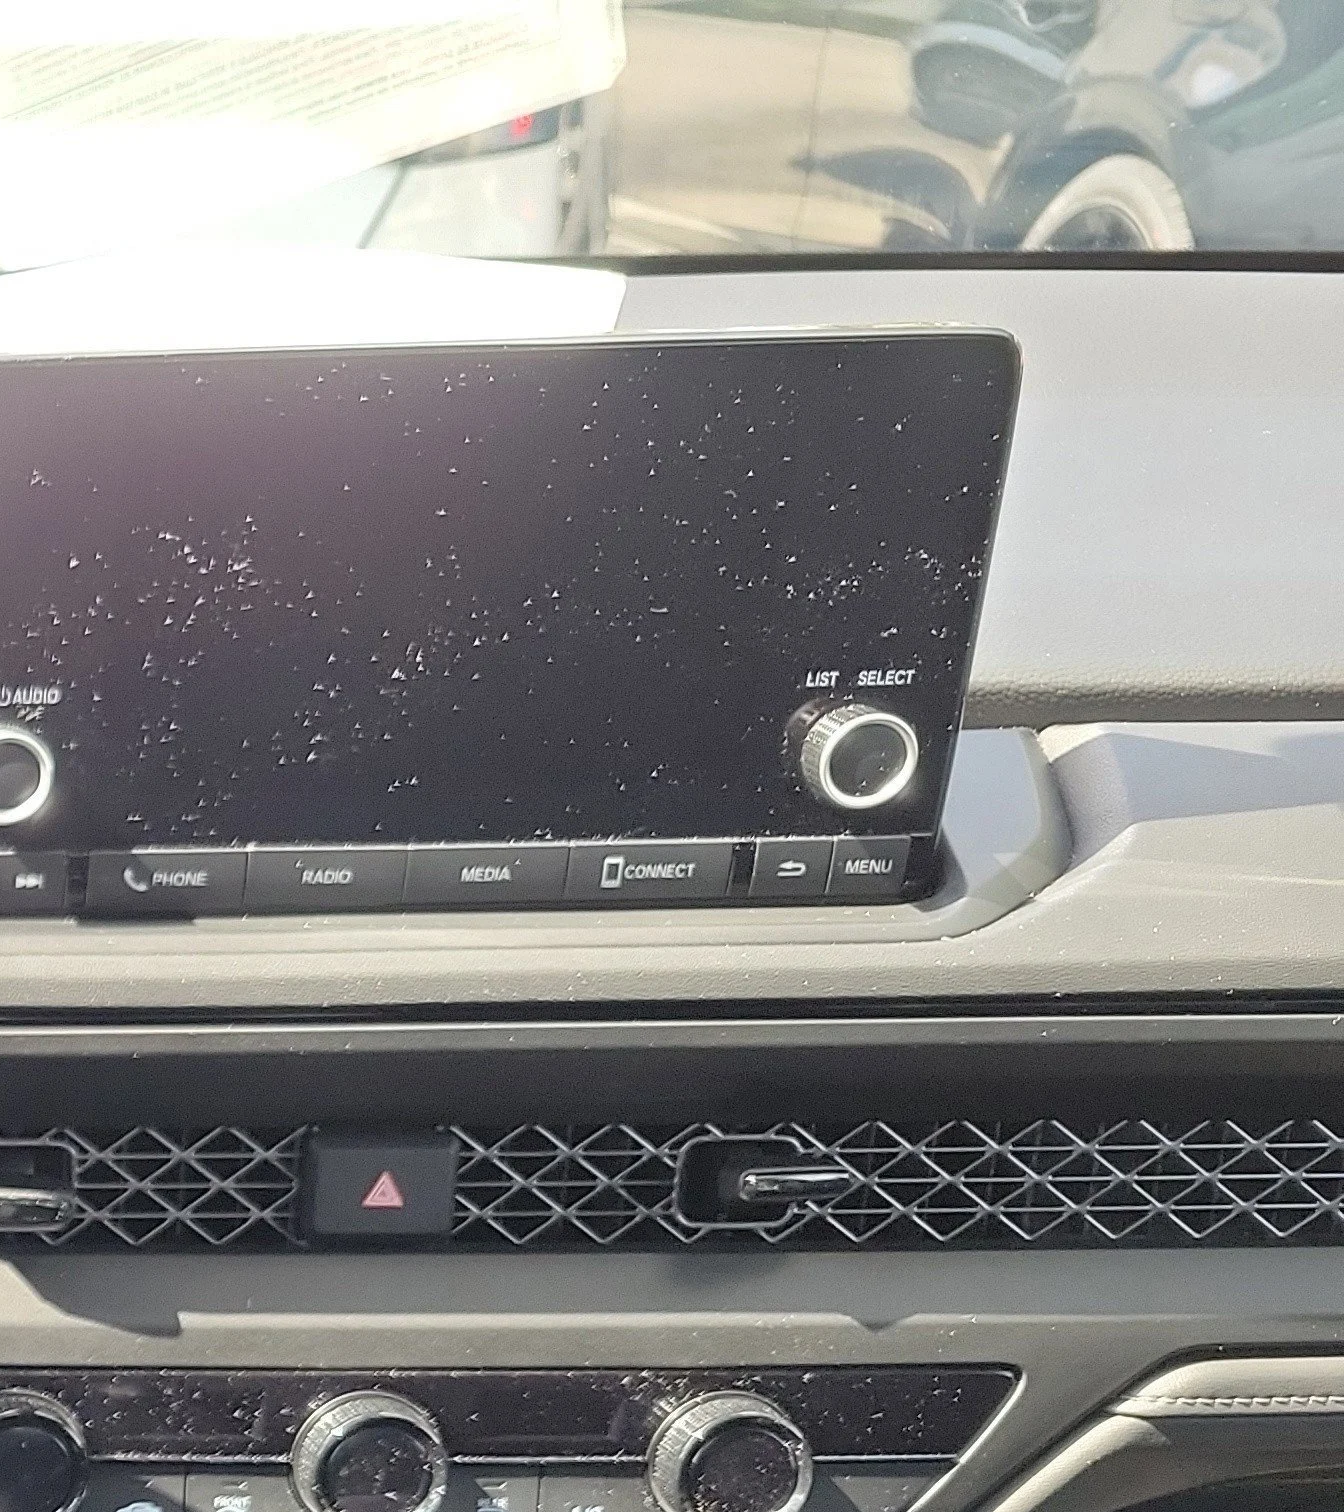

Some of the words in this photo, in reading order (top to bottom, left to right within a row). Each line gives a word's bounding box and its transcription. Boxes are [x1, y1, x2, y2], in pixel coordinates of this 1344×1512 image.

[805, 670, 840, 688] LIST
[857, 668, 916, 686] SELECT
[12, 684, 62, 705] AUDIO
[460, 866, 511, 883] MEDIA
[623, 862, 696, 880] CONNECT
[844, 858, 893, 875] MENU
[151, 871, 209, 887] PHONE
[301, 869, 353, 885] RADIO
